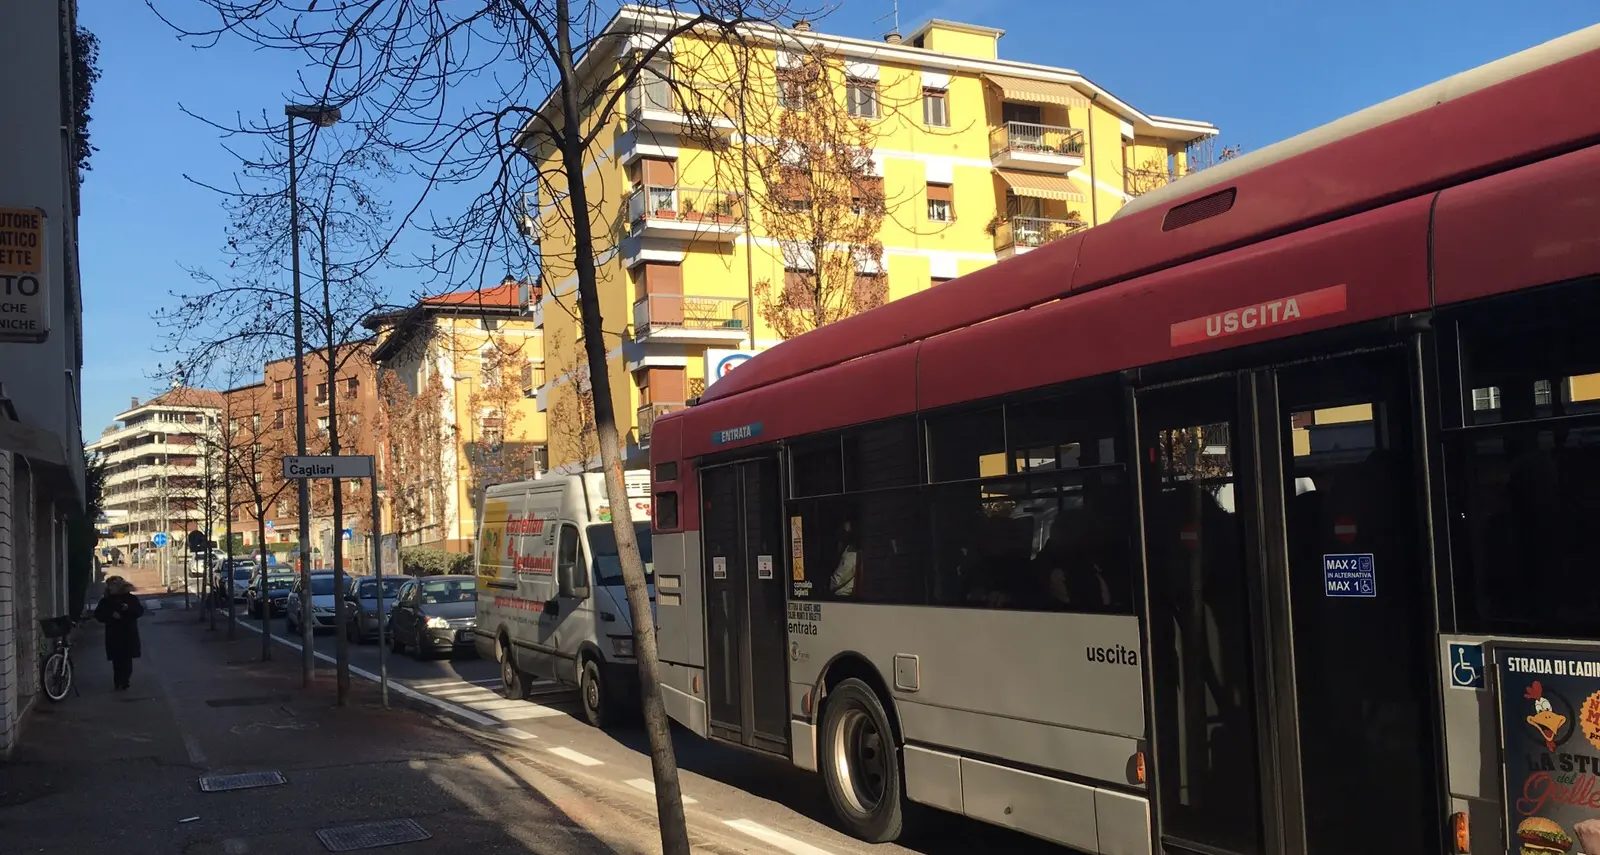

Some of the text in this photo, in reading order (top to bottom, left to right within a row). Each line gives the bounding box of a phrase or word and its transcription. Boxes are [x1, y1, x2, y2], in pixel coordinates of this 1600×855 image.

[0, 302, 27, 313] CHE
[1206, 298, 1300, 336] USCITA
[721, 425, 751, 443] ENTRATA
[289, 464, 334, 476] Cagliari
[1327, 559, 1357, 570] MAX 2
[1328, 581, 1359, 591] MAX 1
[788, 621, 818, 635] entrata
[1086, 644, 1138, 666] uscita
[1507, 656, 1553, 674] STRADA
[1554, 659, 1567, 675] DI
[1524, 752, 1556, 771] LA
[1557, 772, 1578, 785] del
